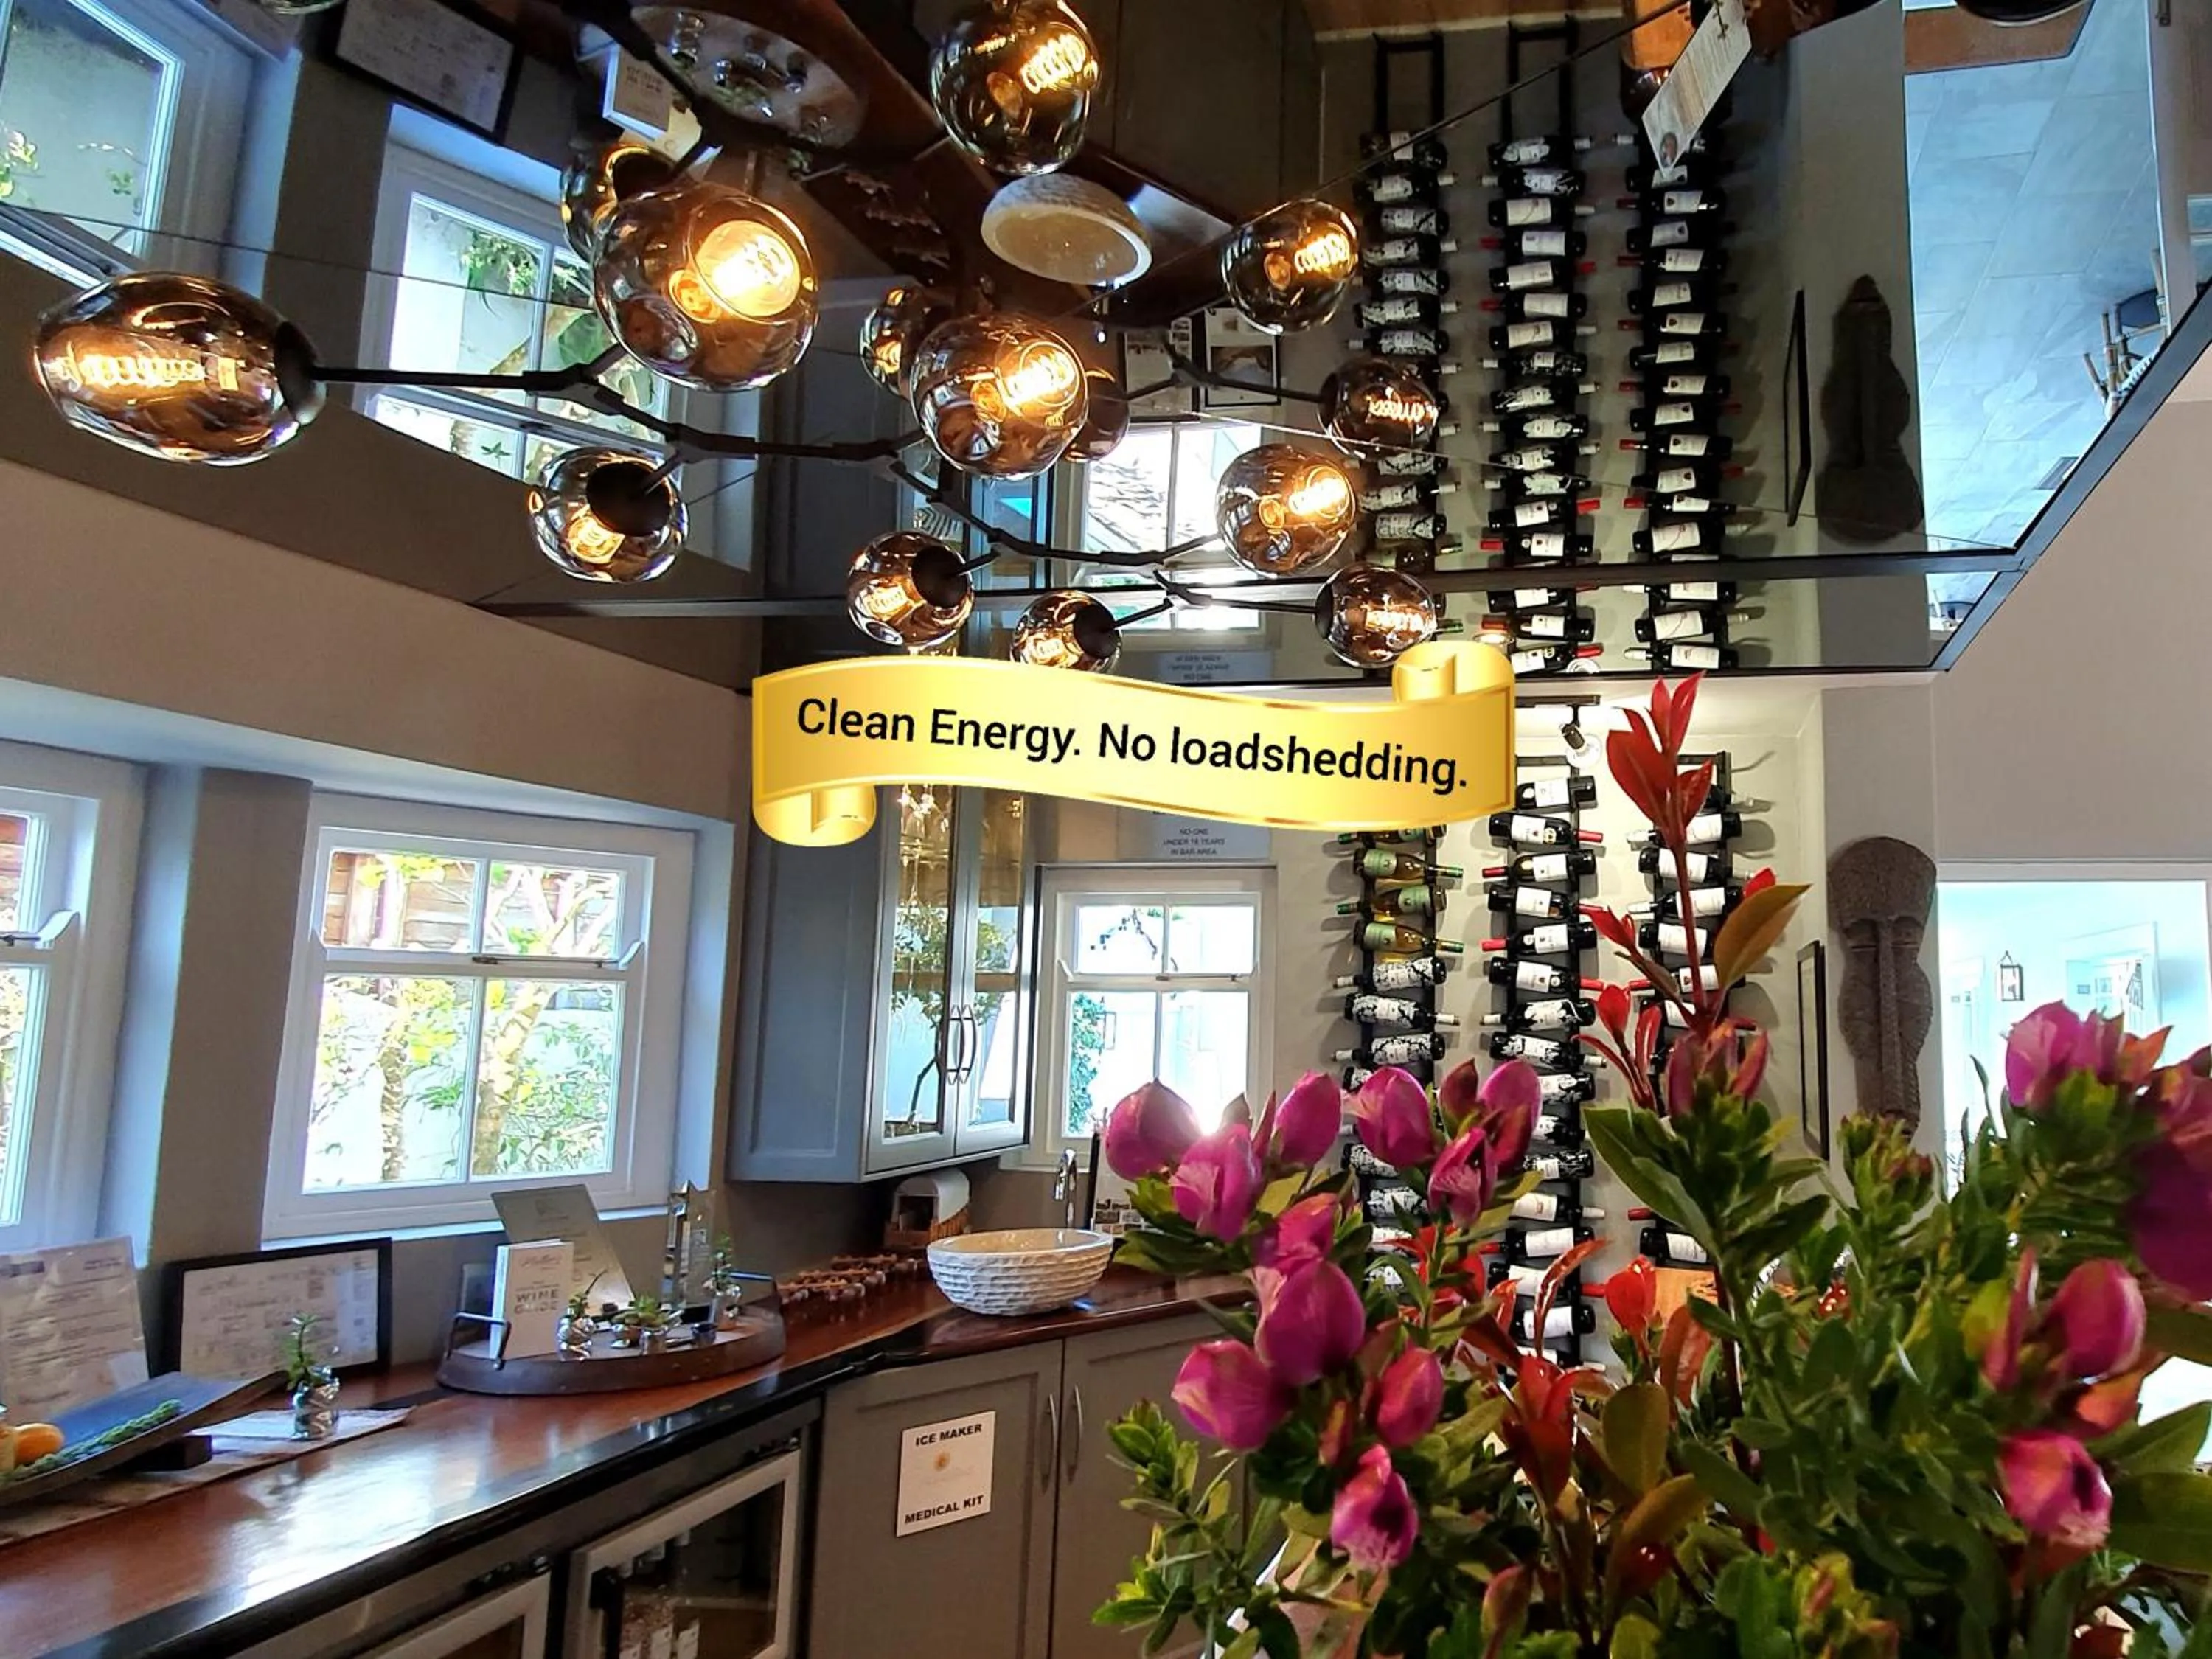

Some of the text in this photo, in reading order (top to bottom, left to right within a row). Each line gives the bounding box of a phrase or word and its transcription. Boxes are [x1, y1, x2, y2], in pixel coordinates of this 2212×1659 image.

[516, 1288, 560, 1303] WINE
[915, 1423, 983, 1447] ICE MAKER
[904, 1495, 984, 1525] MEDICAL KIT
